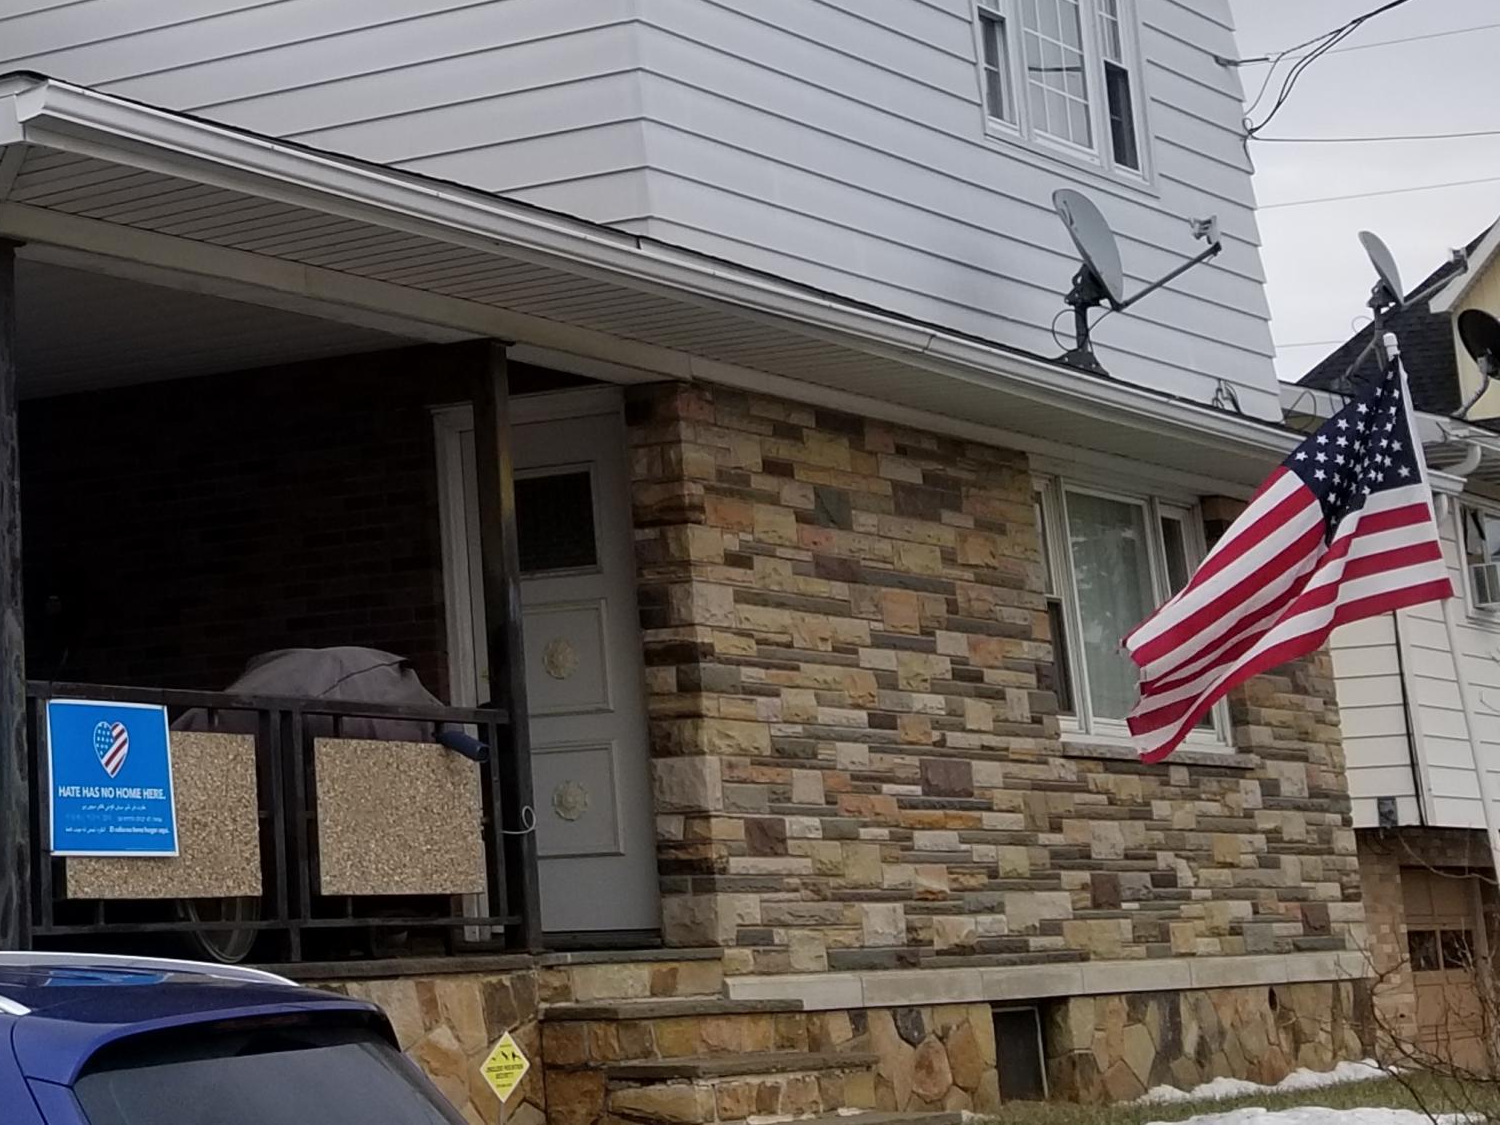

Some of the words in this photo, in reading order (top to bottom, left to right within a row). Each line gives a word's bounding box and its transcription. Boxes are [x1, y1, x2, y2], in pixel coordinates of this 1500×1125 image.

[58, 786, 80, 798] HATE
[82, 786, 99, 798] HAS
[101, 787, 115, 799] NO
[116, 787, 142, 799] HOME
